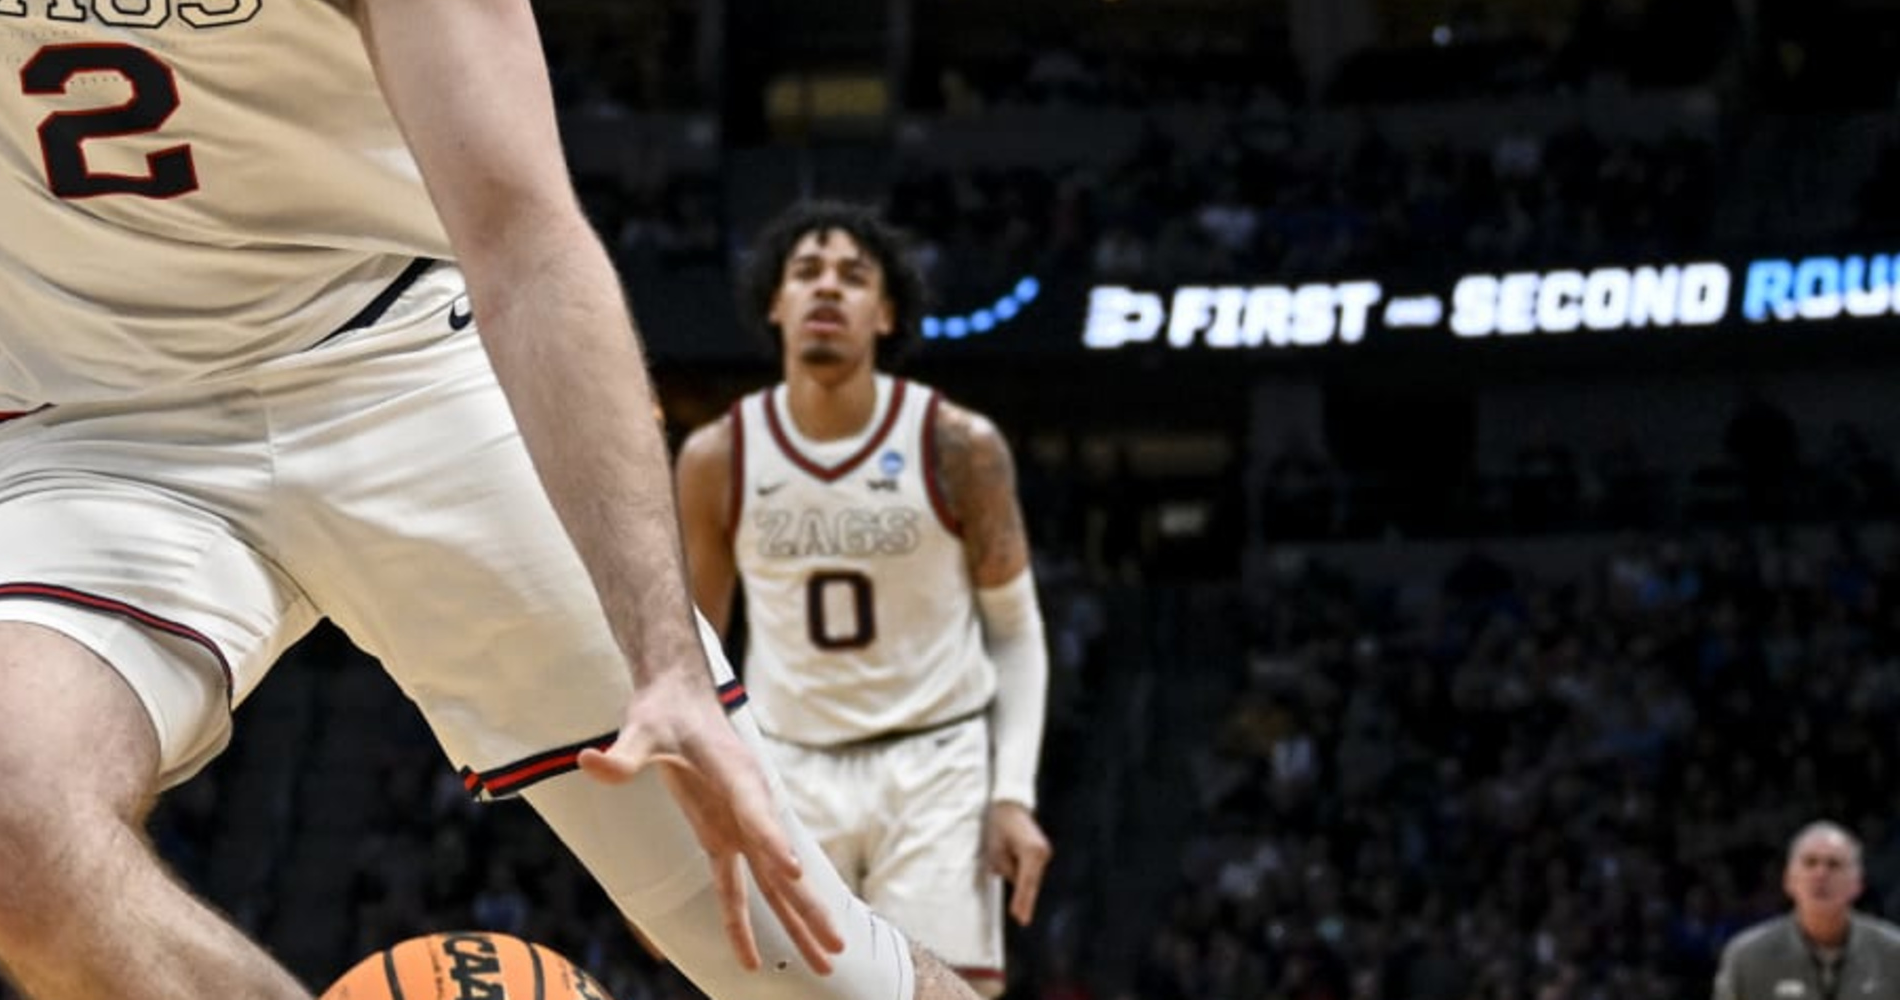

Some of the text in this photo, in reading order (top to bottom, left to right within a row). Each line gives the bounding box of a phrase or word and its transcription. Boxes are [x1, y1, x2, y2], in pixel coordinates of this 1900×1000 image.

[19, 42, 199, 199] 2
[1167, 280, 1382, 349] FIRST
[1450, 262, 1731, 337] SECOND
[1743, 253, 1900, 323] ROU
[756, 506, 921, 557] ZAGS
[806, 569, 877, 653] 0
